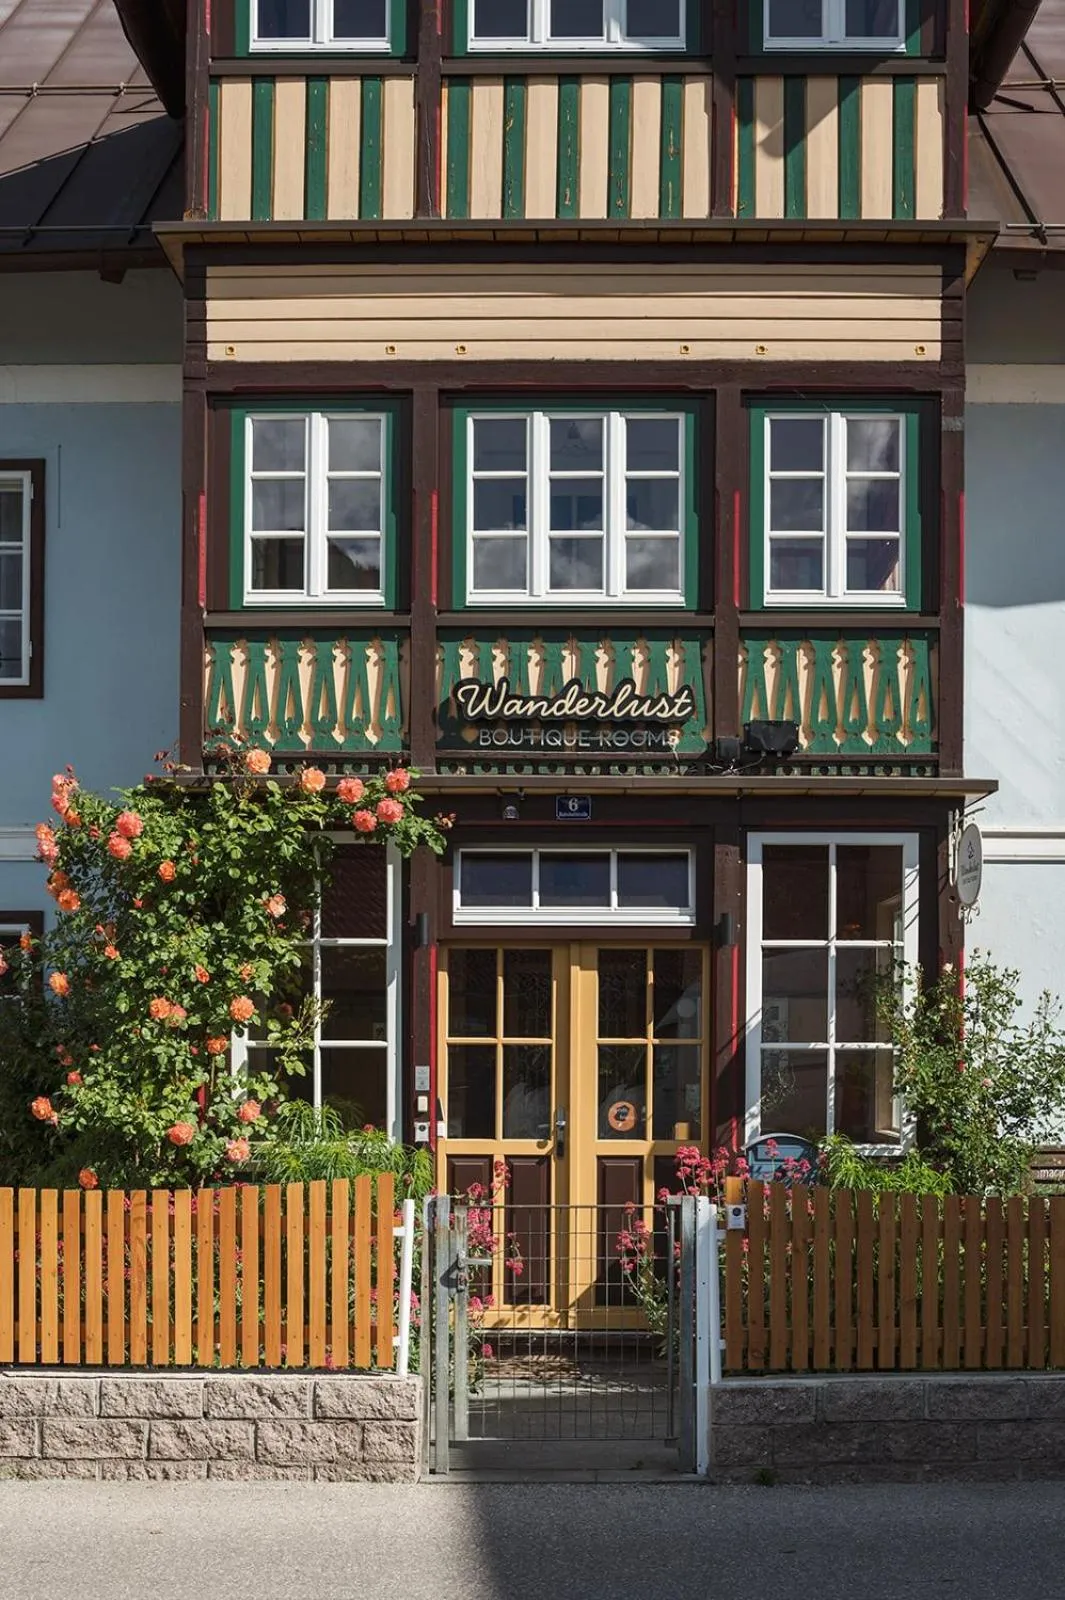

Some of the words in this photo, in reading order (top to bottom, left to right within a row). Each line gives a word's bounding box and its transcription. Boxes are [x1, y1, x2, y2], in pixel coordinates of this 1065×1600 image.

[456, 681, 693, 718] Wanderlust
[478, 729, 591, 747] BOUTIQUE
[599, 729, 681, 747] ROOMS
[568, 797, 579, 812] 6
